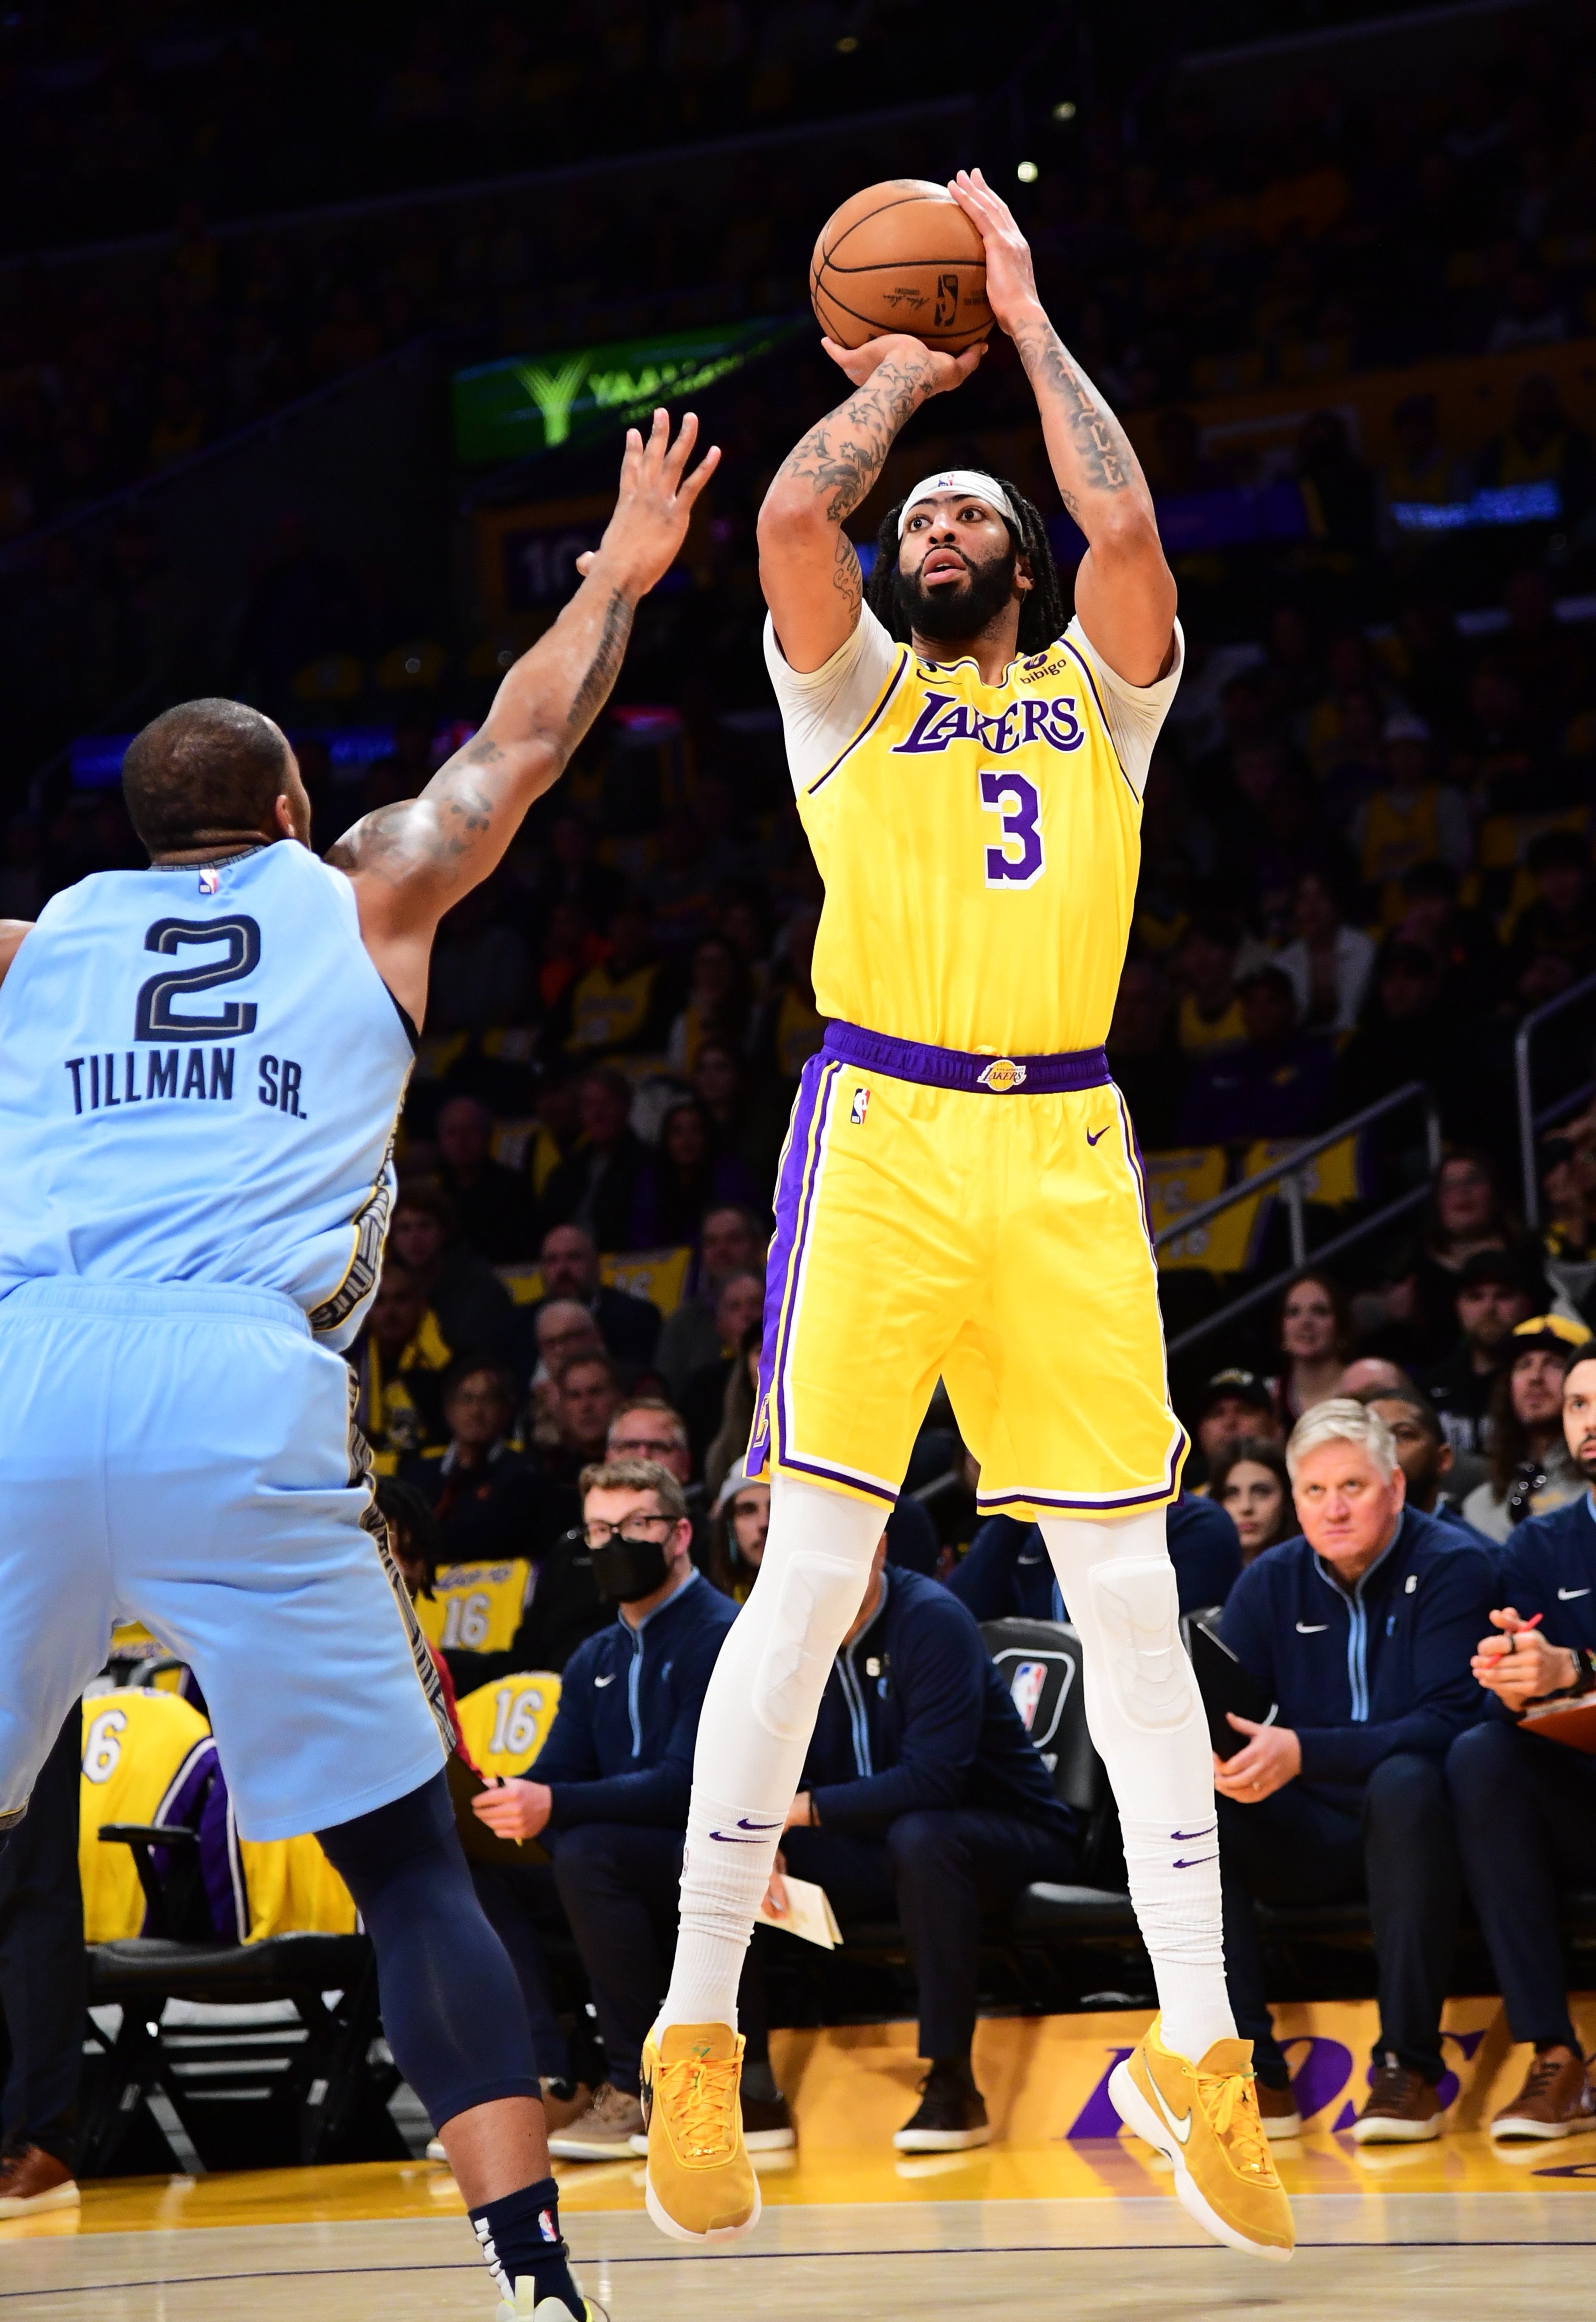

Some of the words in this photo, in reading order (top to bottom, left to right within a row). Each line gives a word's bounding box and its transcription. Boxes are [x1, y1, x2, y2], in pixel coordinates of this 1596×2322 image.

[1020, 659, 1067, 684] bibigo
[888, 689, 1085, 755] LAKERS
[978, 770, 1046, 891] 3
[134, 914, 261, 1042] 2
[64, 1048, 235, 1115] TILLMAN
[258, 1054, 307, 1120] SR.
[981, 1067, 1024, 1083] LAKERS
[441, 1592, 491, 1649] 16
[489, 1688, 543, 1755] 16
